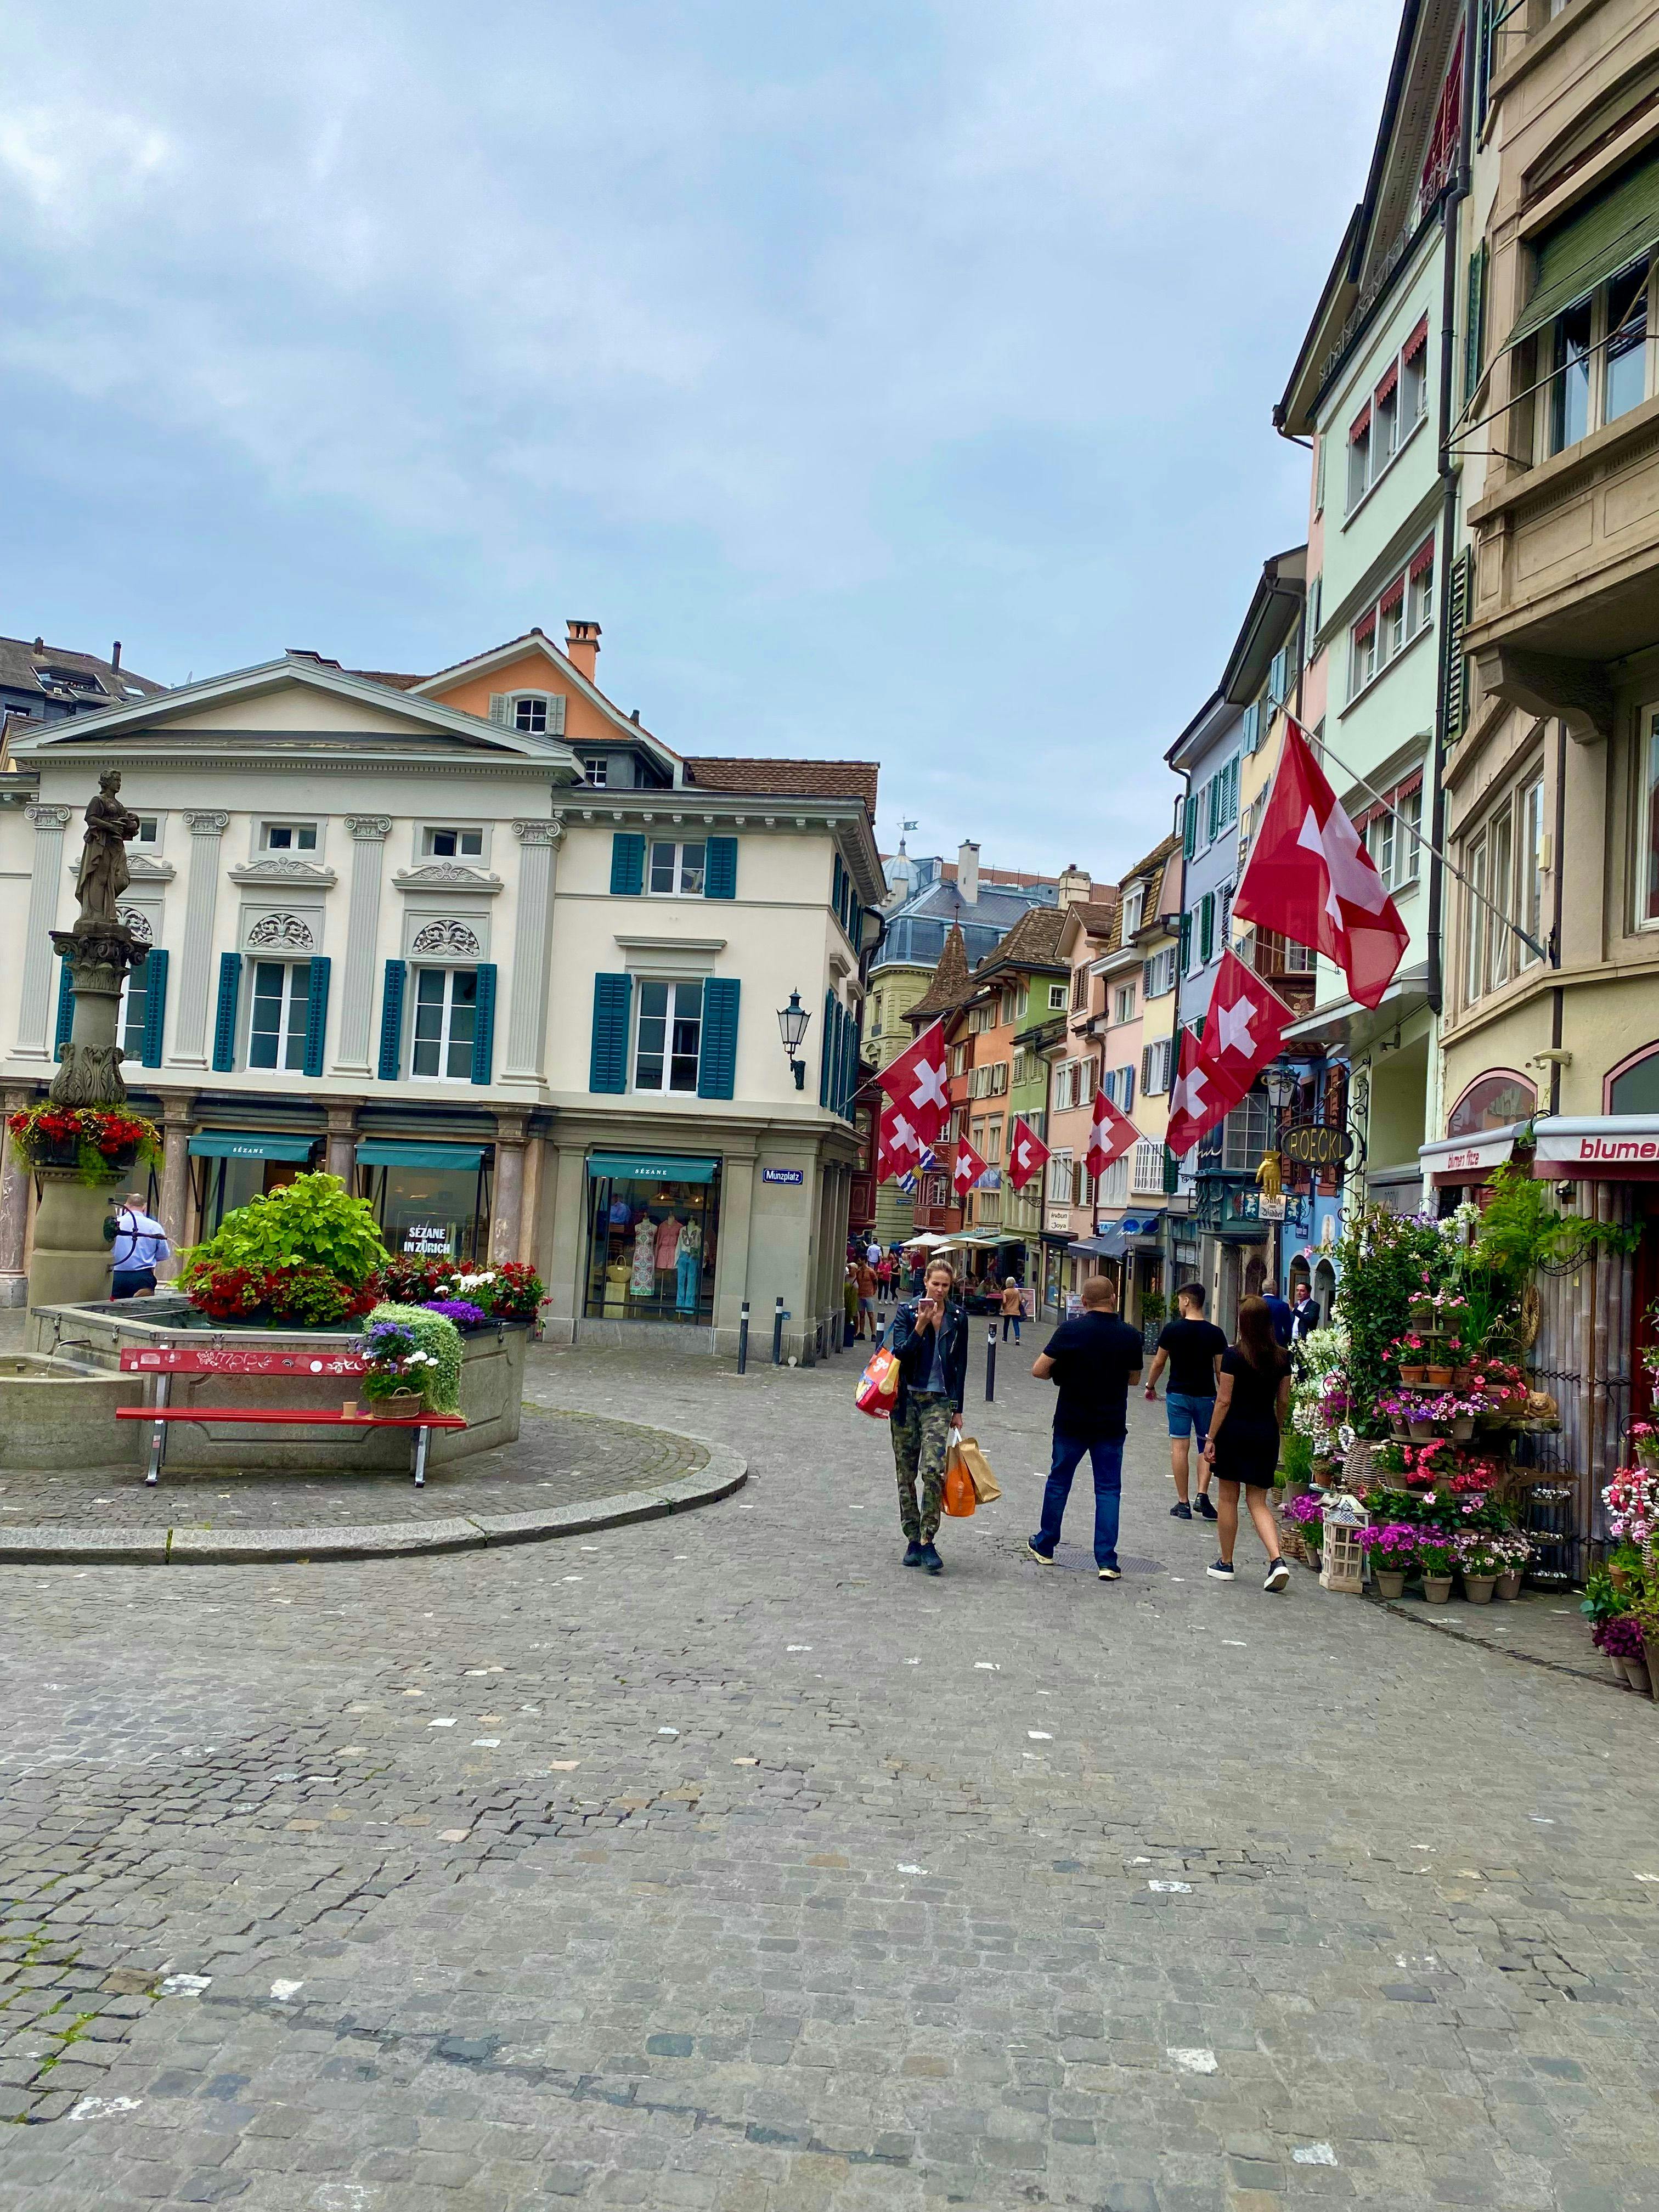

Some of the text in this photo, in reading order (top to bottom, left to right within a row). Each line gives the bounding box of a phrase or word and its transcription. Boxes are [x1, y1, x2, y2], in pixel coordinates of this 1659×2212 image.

[1290, 1128, 1345, 1163] ROECKL
[1580, 1138, 1659, 1159] blume
[766, 1170, 799, 1182] Münzplatz
[1261, 1207, 1283, 1218] Widder
[409, 1224, 445, 1239] SÉZANE
[404, 1240, 450, 1254] IN ZÜRICH
